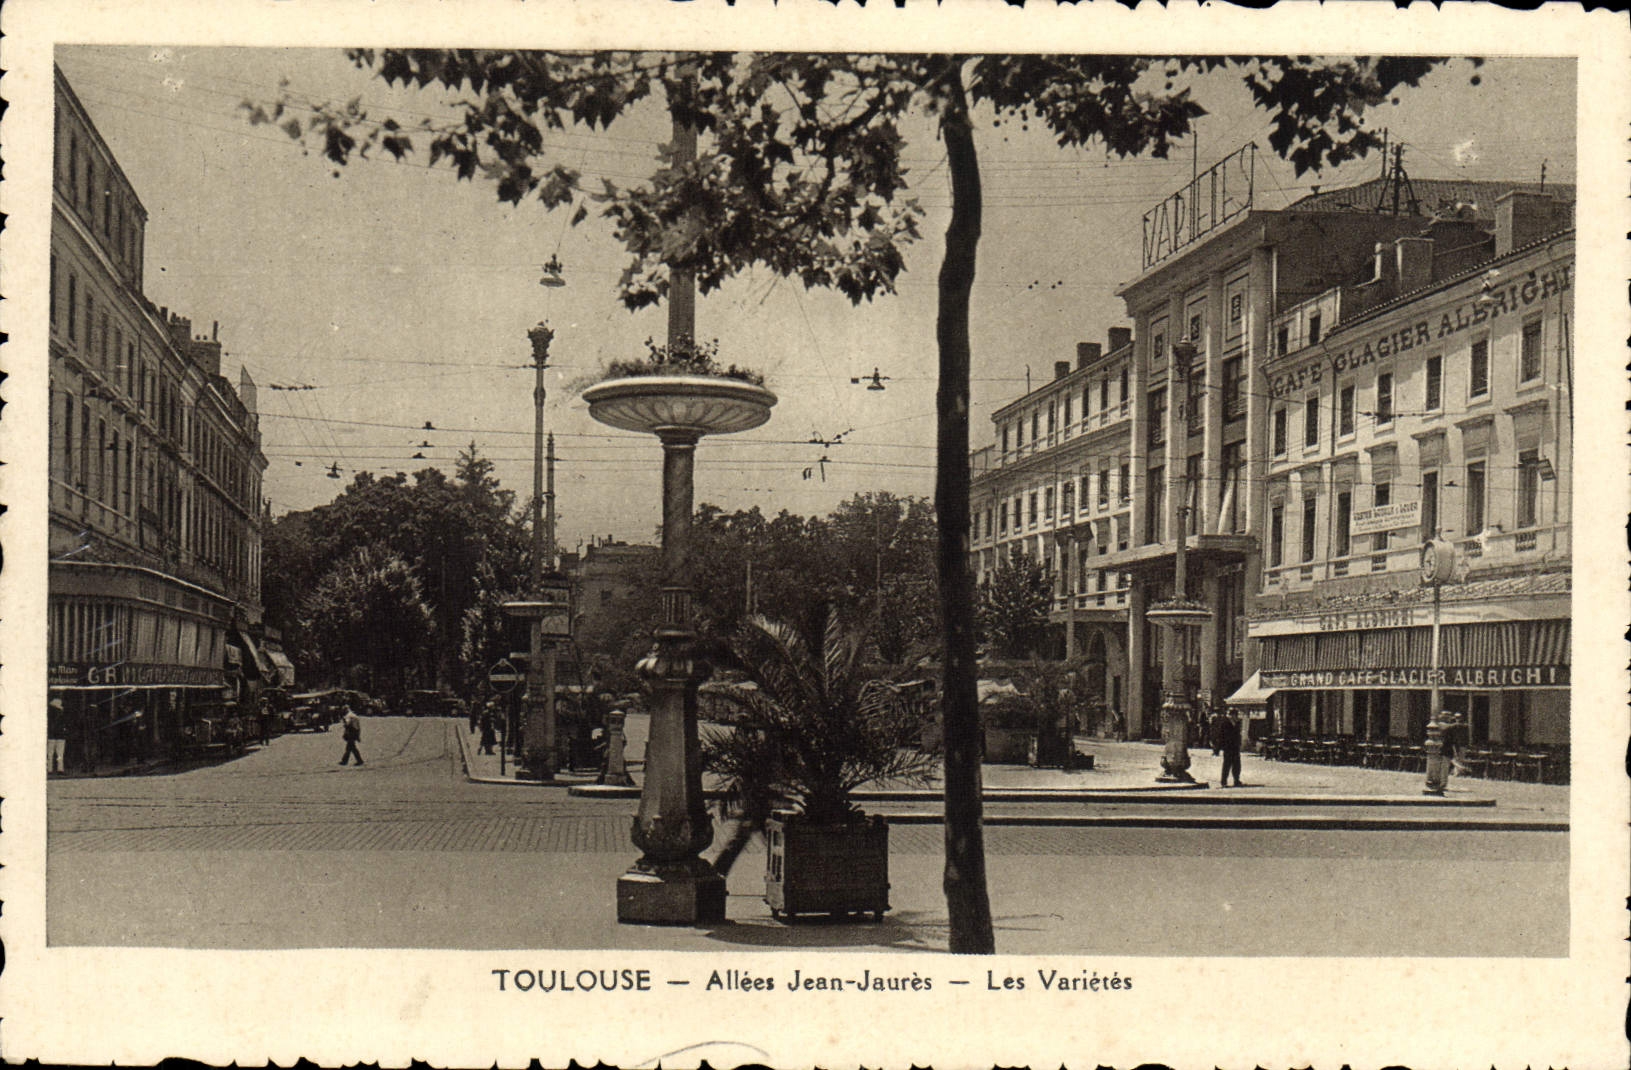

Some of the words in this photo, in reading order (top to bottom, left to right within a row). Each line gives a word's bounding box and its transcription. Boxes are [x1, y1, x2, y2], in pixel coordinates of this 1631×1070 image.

[1290, 672, 1333, 686] GRAND
[1339, 671, 1373, 685] CAFE
[1379, 669, 1446, 685] GLACIER
[1454, 667, 1556, 685] ALBRIGHI
